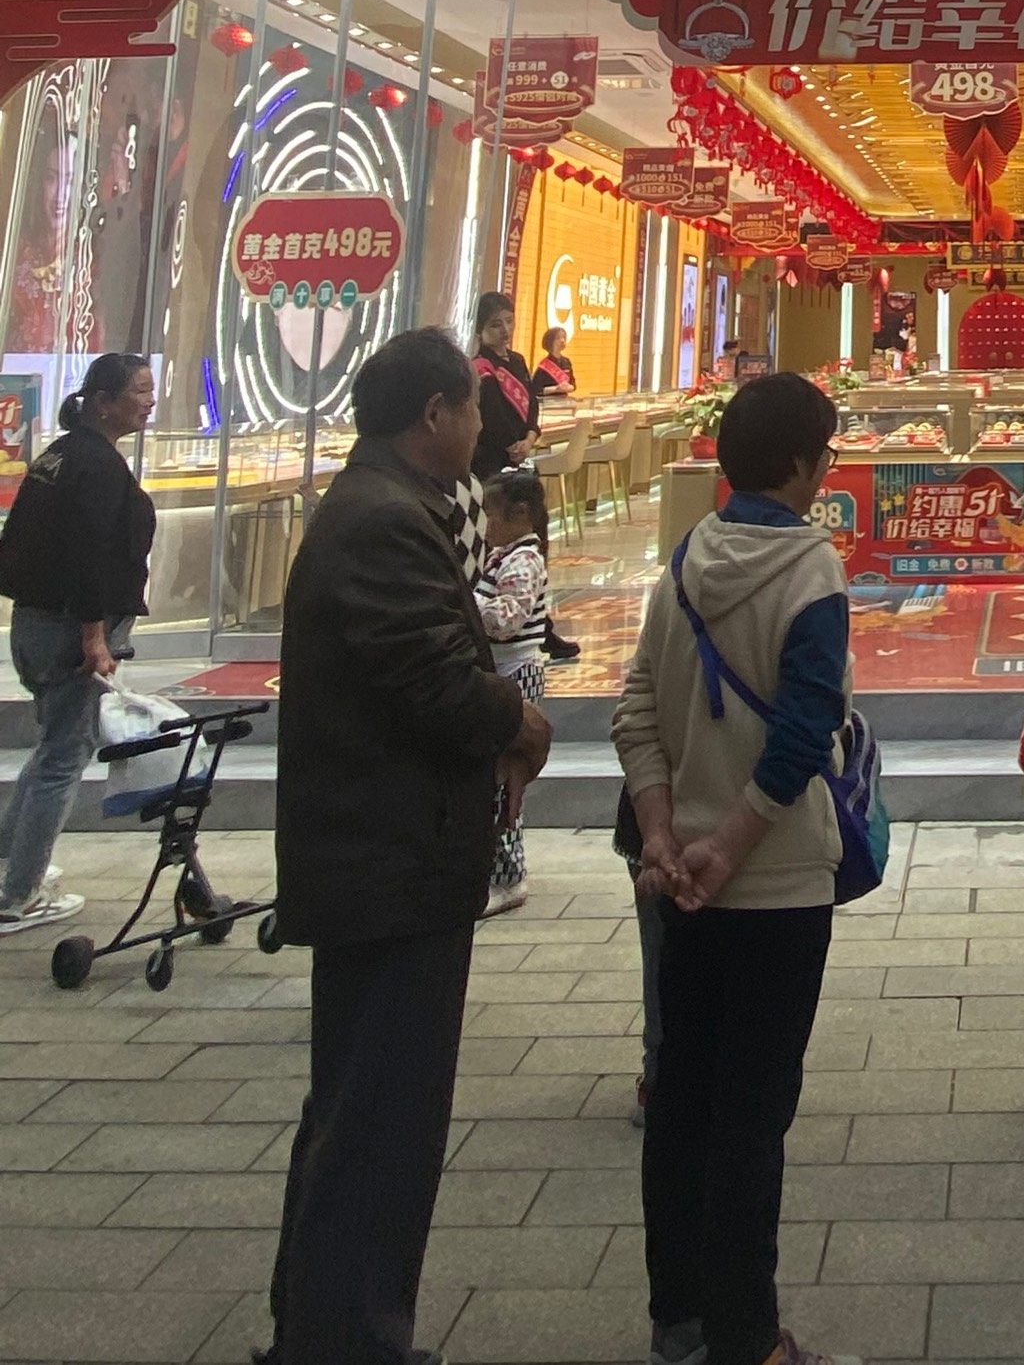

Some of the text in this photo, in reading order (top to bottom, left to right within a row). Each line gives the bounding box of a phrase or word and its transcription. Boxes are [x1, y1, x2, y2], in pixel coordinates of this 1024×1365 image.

[931, 72, 995, 101] 498
[241, 226, 393, 261] 黄金首克498元
[885, 518, 976, 538] 价给幸福
